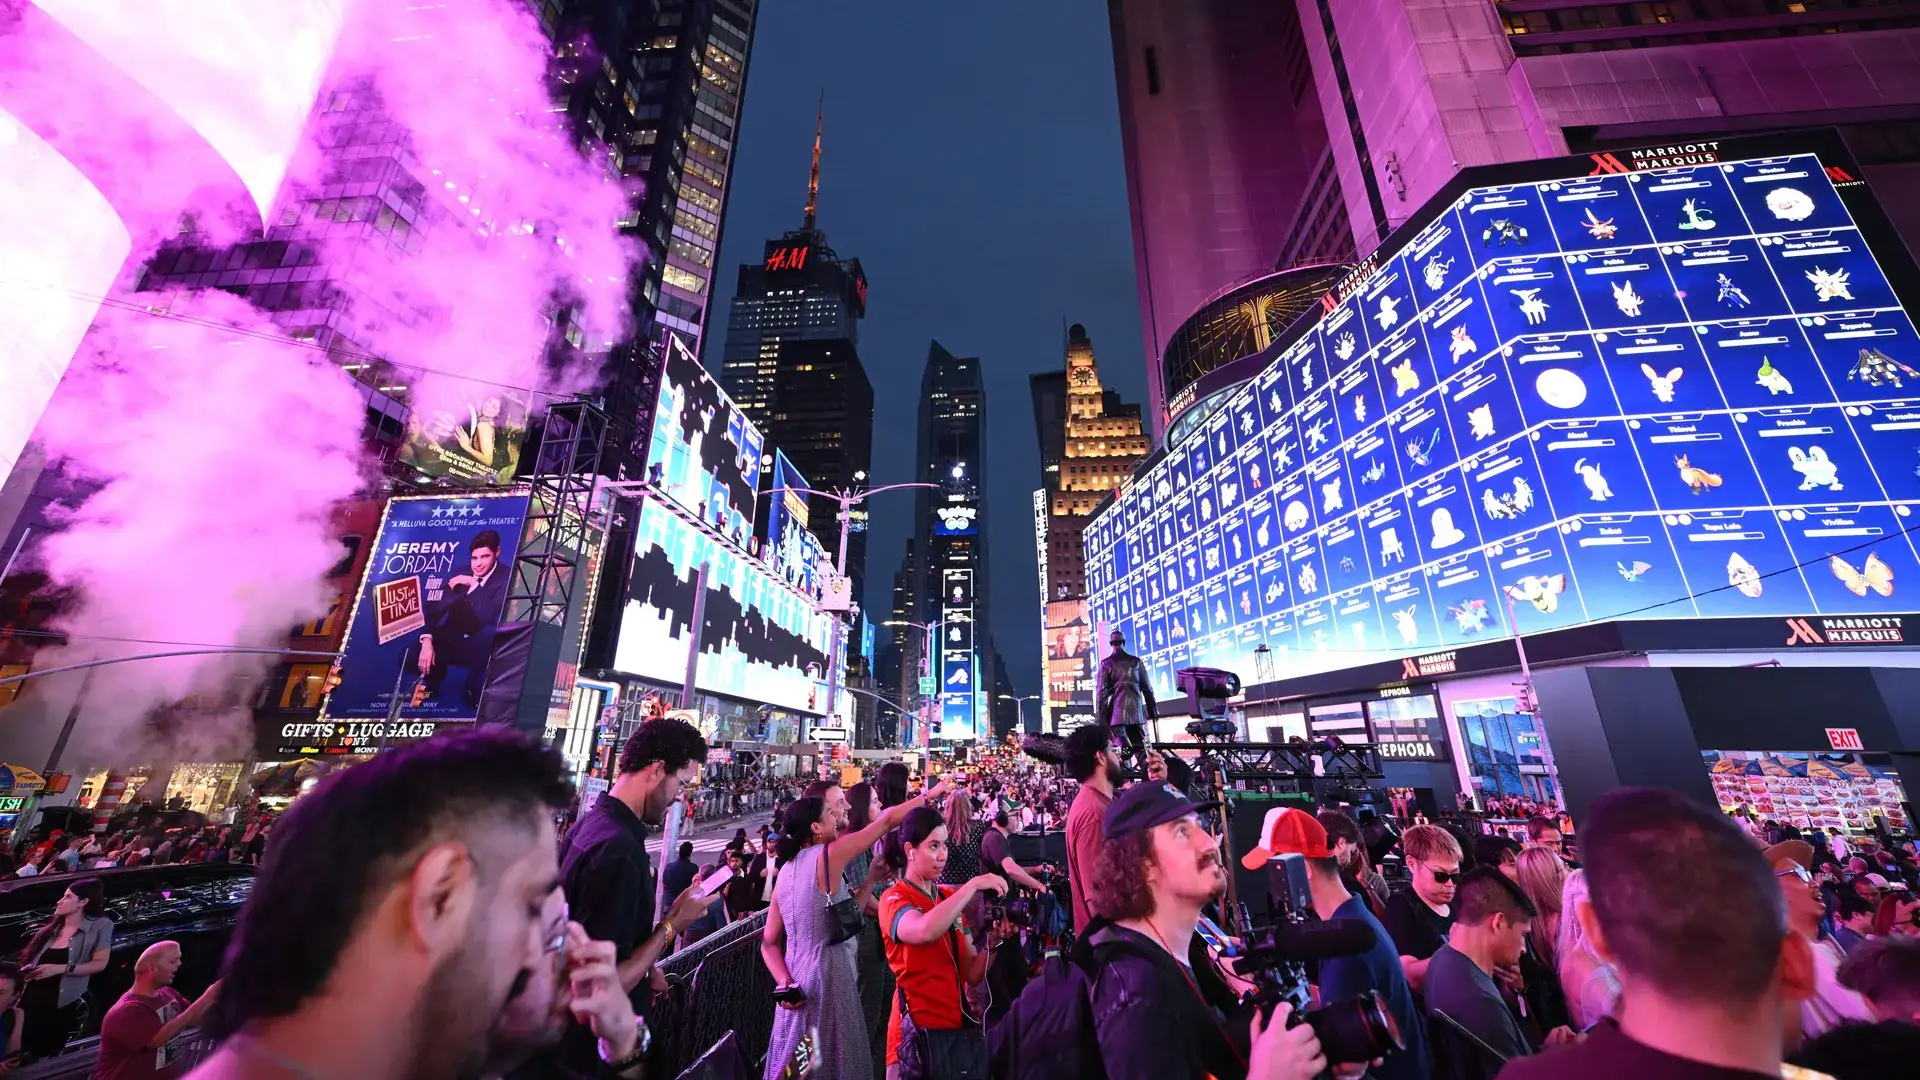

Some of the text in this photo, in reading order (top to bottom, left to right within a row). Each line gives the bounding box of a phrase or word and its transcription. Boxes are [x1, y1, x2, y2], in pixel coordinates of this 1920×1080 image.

[1631, 142, 1719, 159] MARRIOTT
[1636, 153, 1715, 170] MARQUIS
[765, 246, 809, 271] H&M
[1338, 250, 1380, 291] MARRIOTT
[1340, 264, 1377, 299] MARQUIS
[1169, 382, 1198, 408] MARRIOTT
[1170, 394, 1196, 418] MARQUIS
[398, 520, 426, 528] HELLUVA
[427, 519, 452, 527] GOOD
[453, 518, 468, 526] TIME
[385, 541, 460, 554] JEREMY
[379, 554, 454, 574] JORDAN
[382, 585, 416, 606] JUST in
[381, 597, 420, 619] TIME
[1823, 618, 1902, 629] MARRIOTT
[1828, 630, 1900, 641] MARQUIS
[1419, 652, 1456, 665] MARRIOTT
[1421, 662, 1455, 674] MARQUIS
[1052, 680, 1075, 692] THE
[1380, 686, 1411, 698] SEPHORA
[281, 723, 435, 738] GIFTS LUGGAGE
[1829, 730, 1859, 748] EXIT
[1378, 742, 1435, 757] SEPHORA
